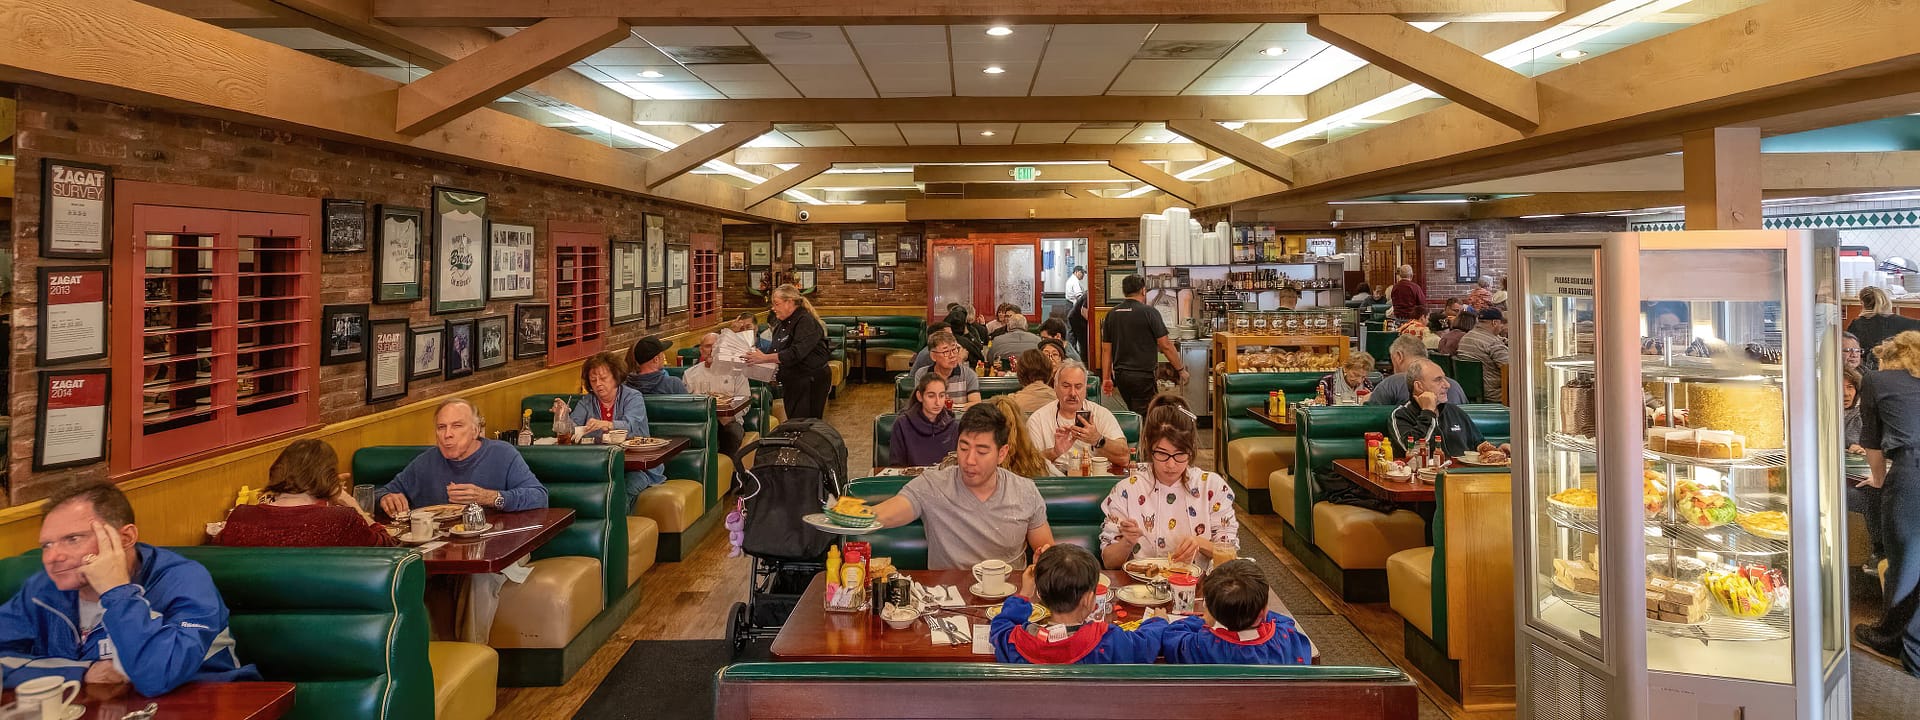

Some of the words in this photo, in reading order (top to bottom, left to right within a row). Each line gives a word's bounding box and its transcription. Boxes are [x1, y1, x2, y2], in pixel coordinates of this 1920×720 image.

[53, 167, 104, 187] ZAGAT
[1018, 167, 1032, 180] EXIT
[53, 183, 104, 200] SURVEY
[50, 275, 82, 286] ZAGAT
[50, 285, 71, 295] 2013
[377, 333, 400, 343] ZAGAT
[51, 379, 85, 390] ZAGAT
[51, 388, 73, 398] 2014
